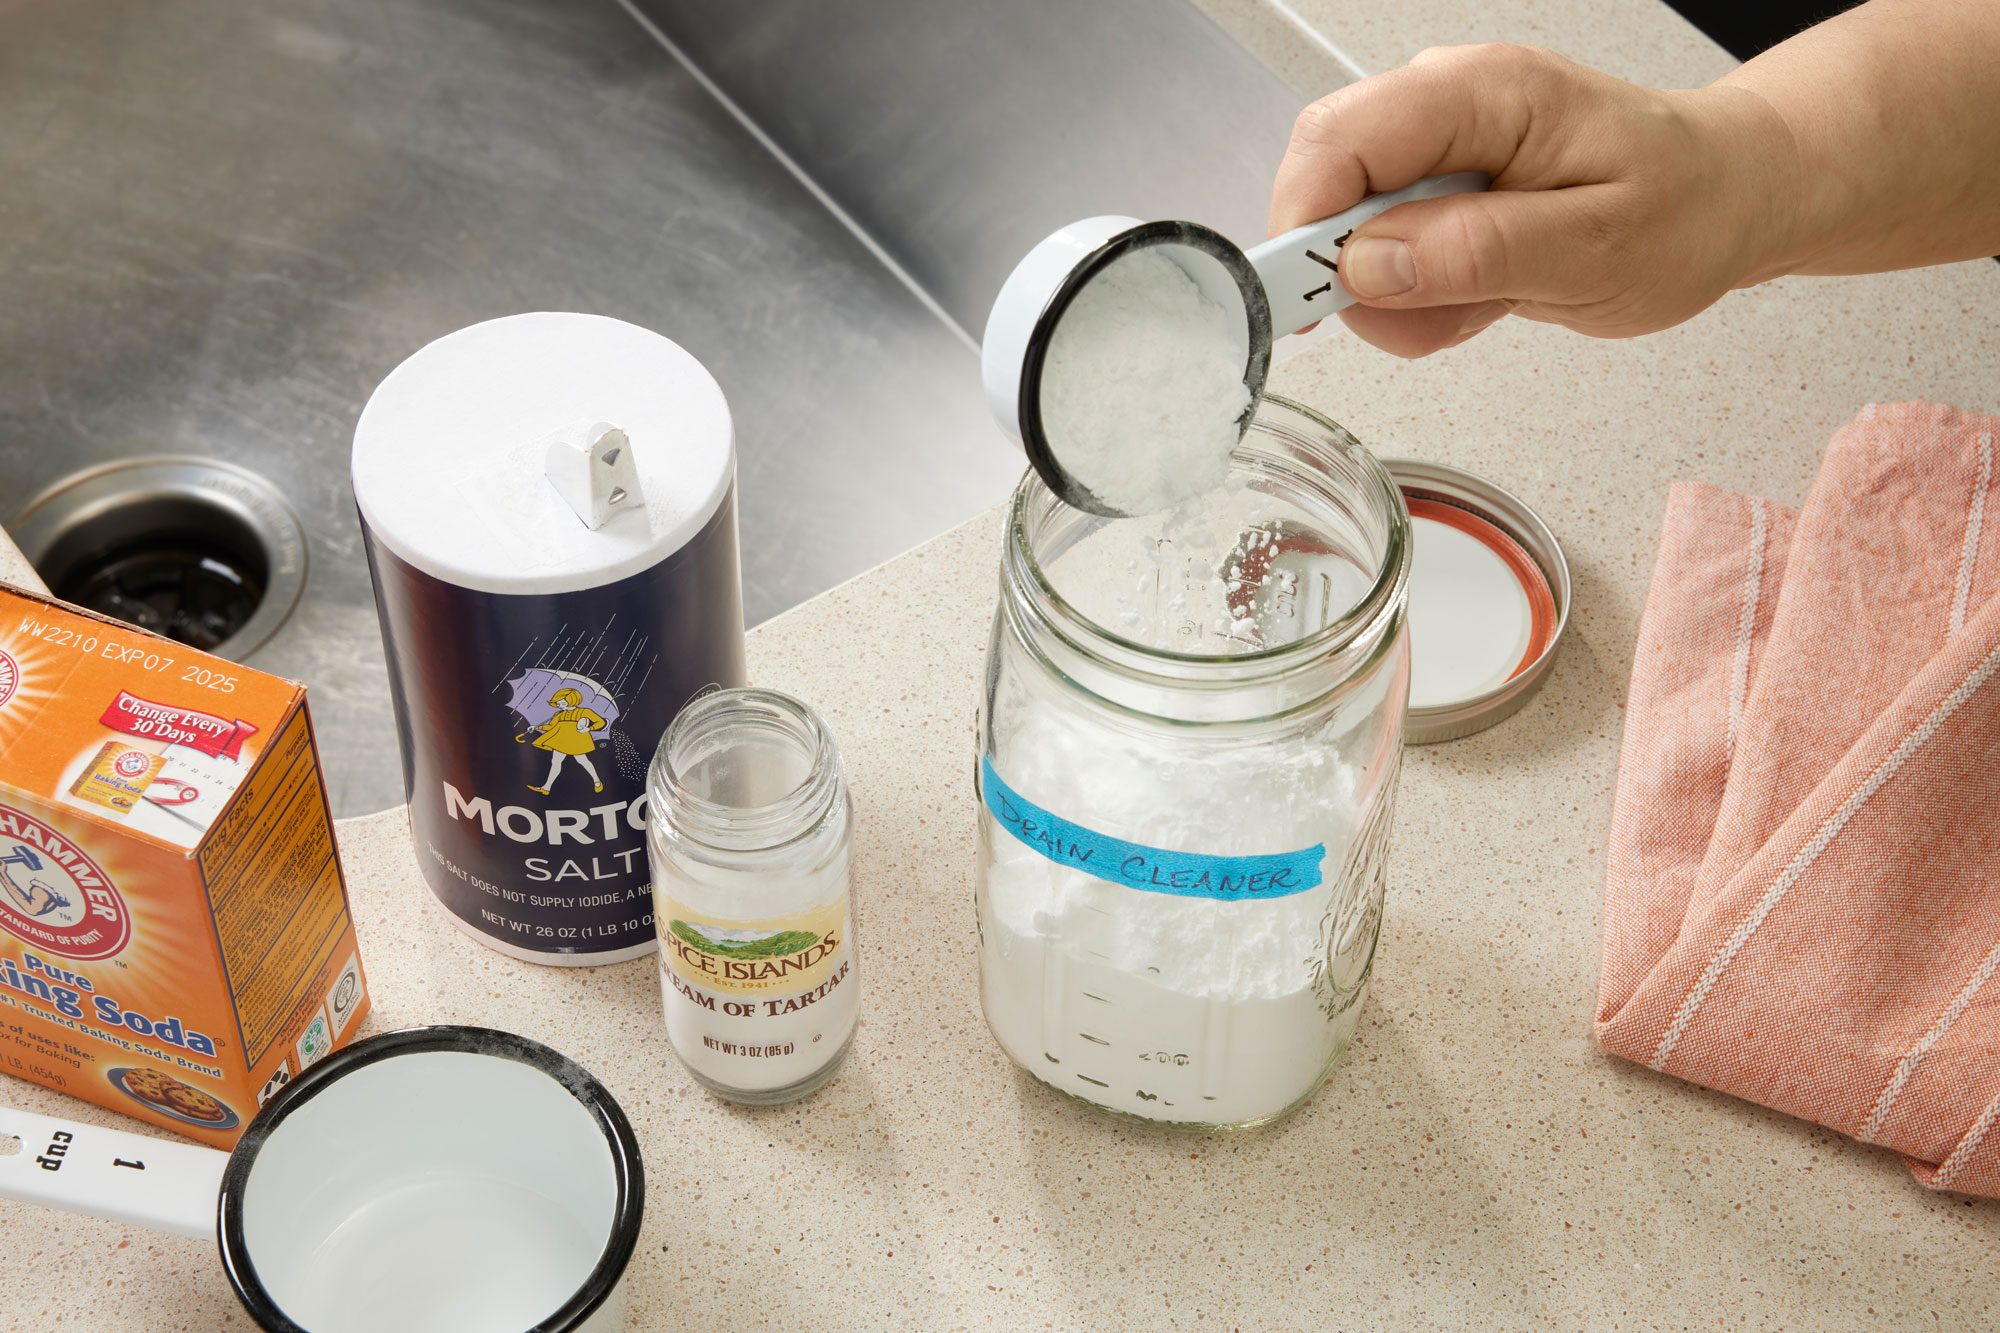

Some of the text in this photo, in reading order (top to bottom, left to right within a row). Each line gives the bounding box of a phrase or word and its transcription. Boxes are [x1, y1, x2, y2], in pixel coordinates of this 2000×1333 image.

[18, 618, 98, 653] WW2210
[181, 665, 239, 693] 2025
[118, 696, 228, 738] Change Every
[130, 717, 197, 744] 30 Days
[997, 791, 1299, 893] DRAIN CLEANER
[0, 813, 118, 922] HAMMER
[427, 840, 445, 866] THIS
[446, 860, 468, 881] SALT
[471, 876, 500, 896] DOES
[503, 889, 526, 904] NOT
[530, 895, 575, 908] SUPPLY
[579, 893, 624, 907] IODIDE,
[626, 889, 635, 900] A
[525, 848, 641, 881] SALT
[0, 907, 104, 946] TANDARD OF PURITY
[482, 908, 506, 927] NET
[509, 920, 531, 934] WT
[535, 926, 554, 938] 26
[558, 927, 578, 938] OZ
[581, 927, 593, 939] (1
[599, 924, 618, 936] LB
[622, 919, 638, 931] 10
[658, 915, 717, 976] SPICE
[24, 952, 93, 992] Pure
[723, 1002, 755, 1017] OF
[763, 960, 850, 1018] TARTAR
[742, 980, 768, 989] 1941
[9, 1025, 96, 1062] of uses like:
[15, 1036, 32, 1049] for
[36, 1044, 81, 1069] Baking
[22, 1002, 75, 1029] Trusted
[80, 1024, 131, 1051] Baking
[134, 1043, 171, 1062] Soda
[177, 1057, 222, 1078] Brand
[703, 1035, 794, 1059] NET WT 3 OZ (85 g)
[29, 1063, 67, 1088] (454g)
[36, 1130, 74, 1172] cup
[112, 1157, 146, 1171] 1
